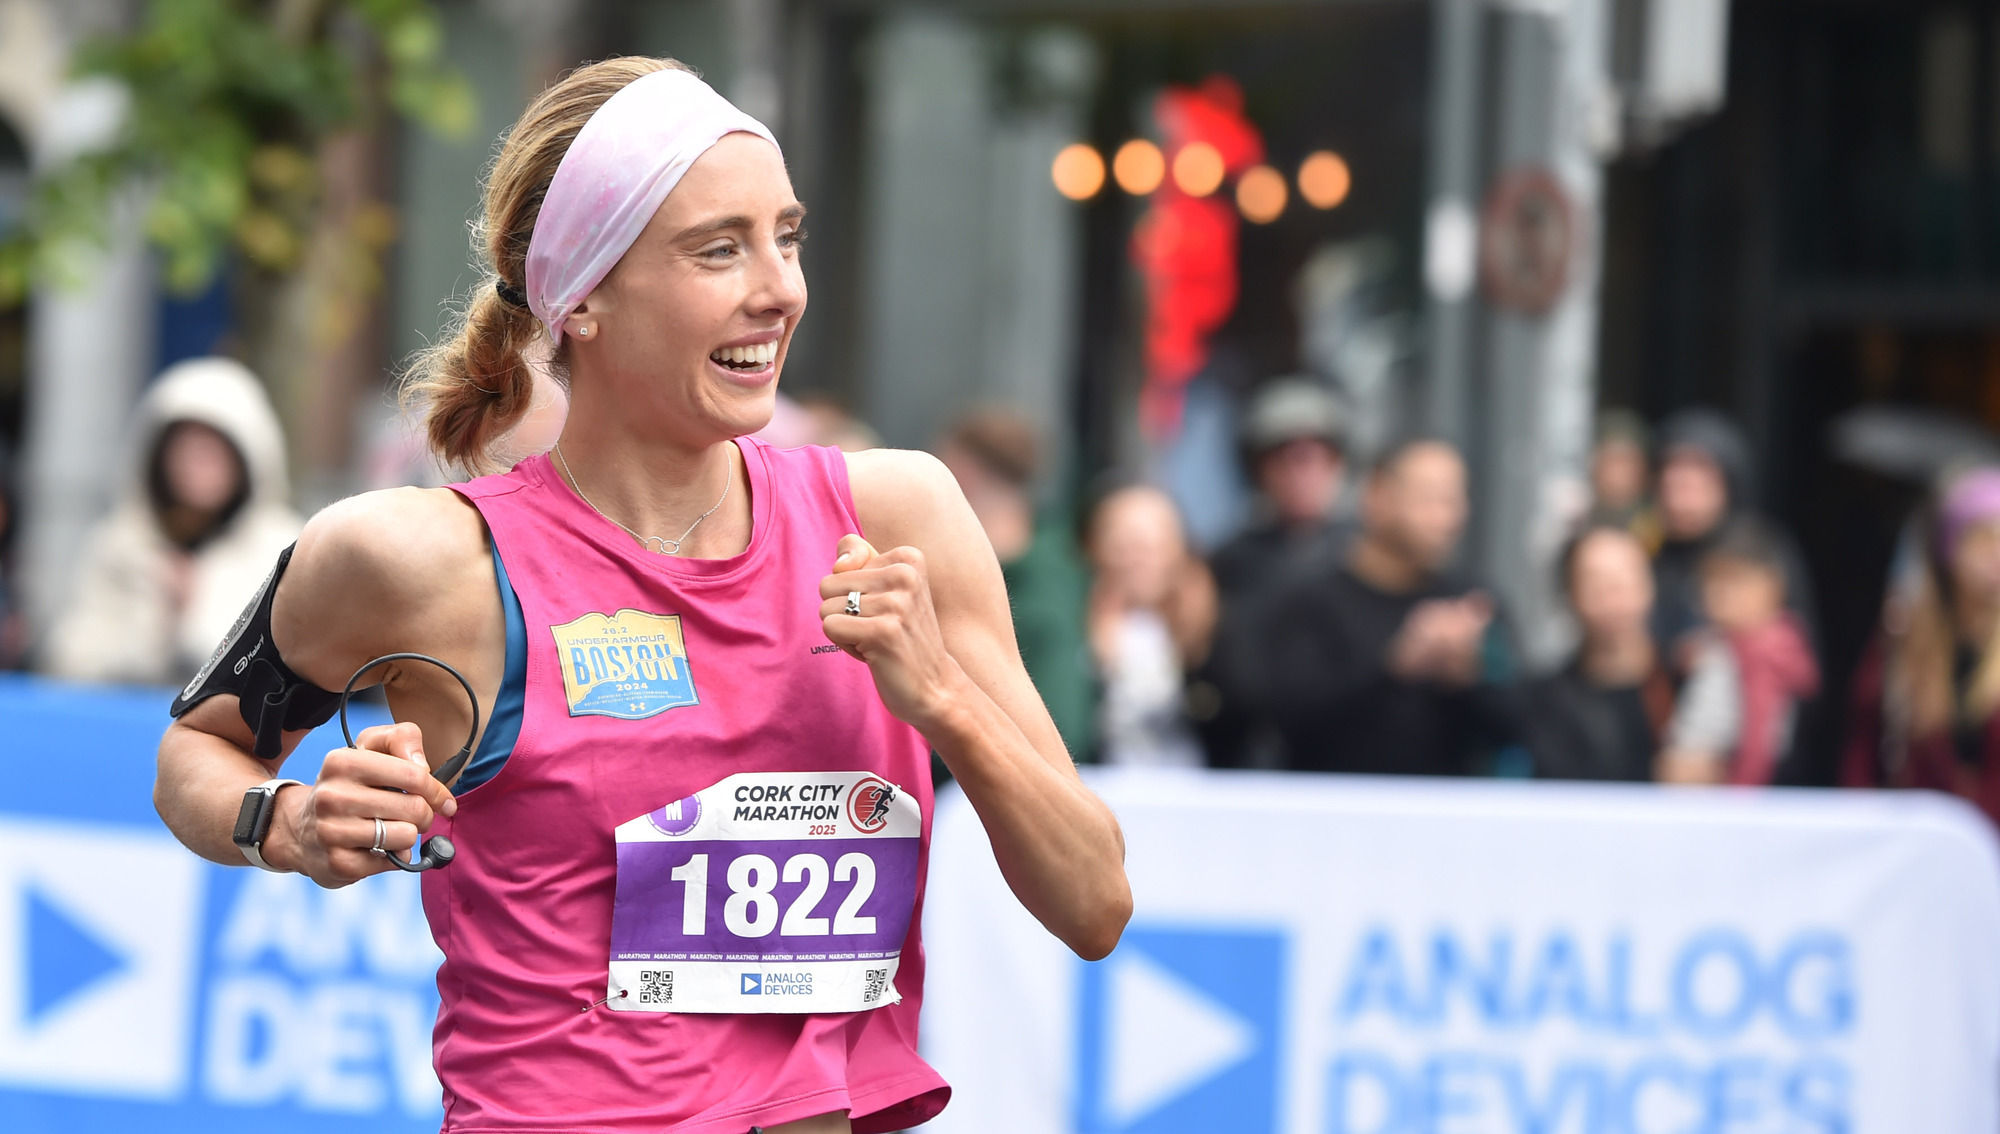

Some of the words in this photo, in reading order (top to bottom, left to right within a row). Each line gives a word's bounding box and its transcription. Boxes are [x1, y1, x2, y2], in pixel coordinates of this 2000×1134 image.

[602, 626, 628, 635] 26.2
[567, 637, 609, 646] UNDER
[612, 634, 666, 644] ARMOUR
[570, 643, 679, 686] BOSTON
[615, 682, 648, 692] 2024
[734, 785, 795, 802] CORK
[799, 784, 845, 802] CITY
[733, 804, 840, 821] MARATHON
[808, 824, 837, 836] 2025
[670, 852, 877, 938] 1822
[689, 953, 723, 961] MARATHON
[765, 973, 813, 984] ANALOG
[1333, 927, 1853, 1038] ANALOG
[764, 984, 813, 995] DEVICES
